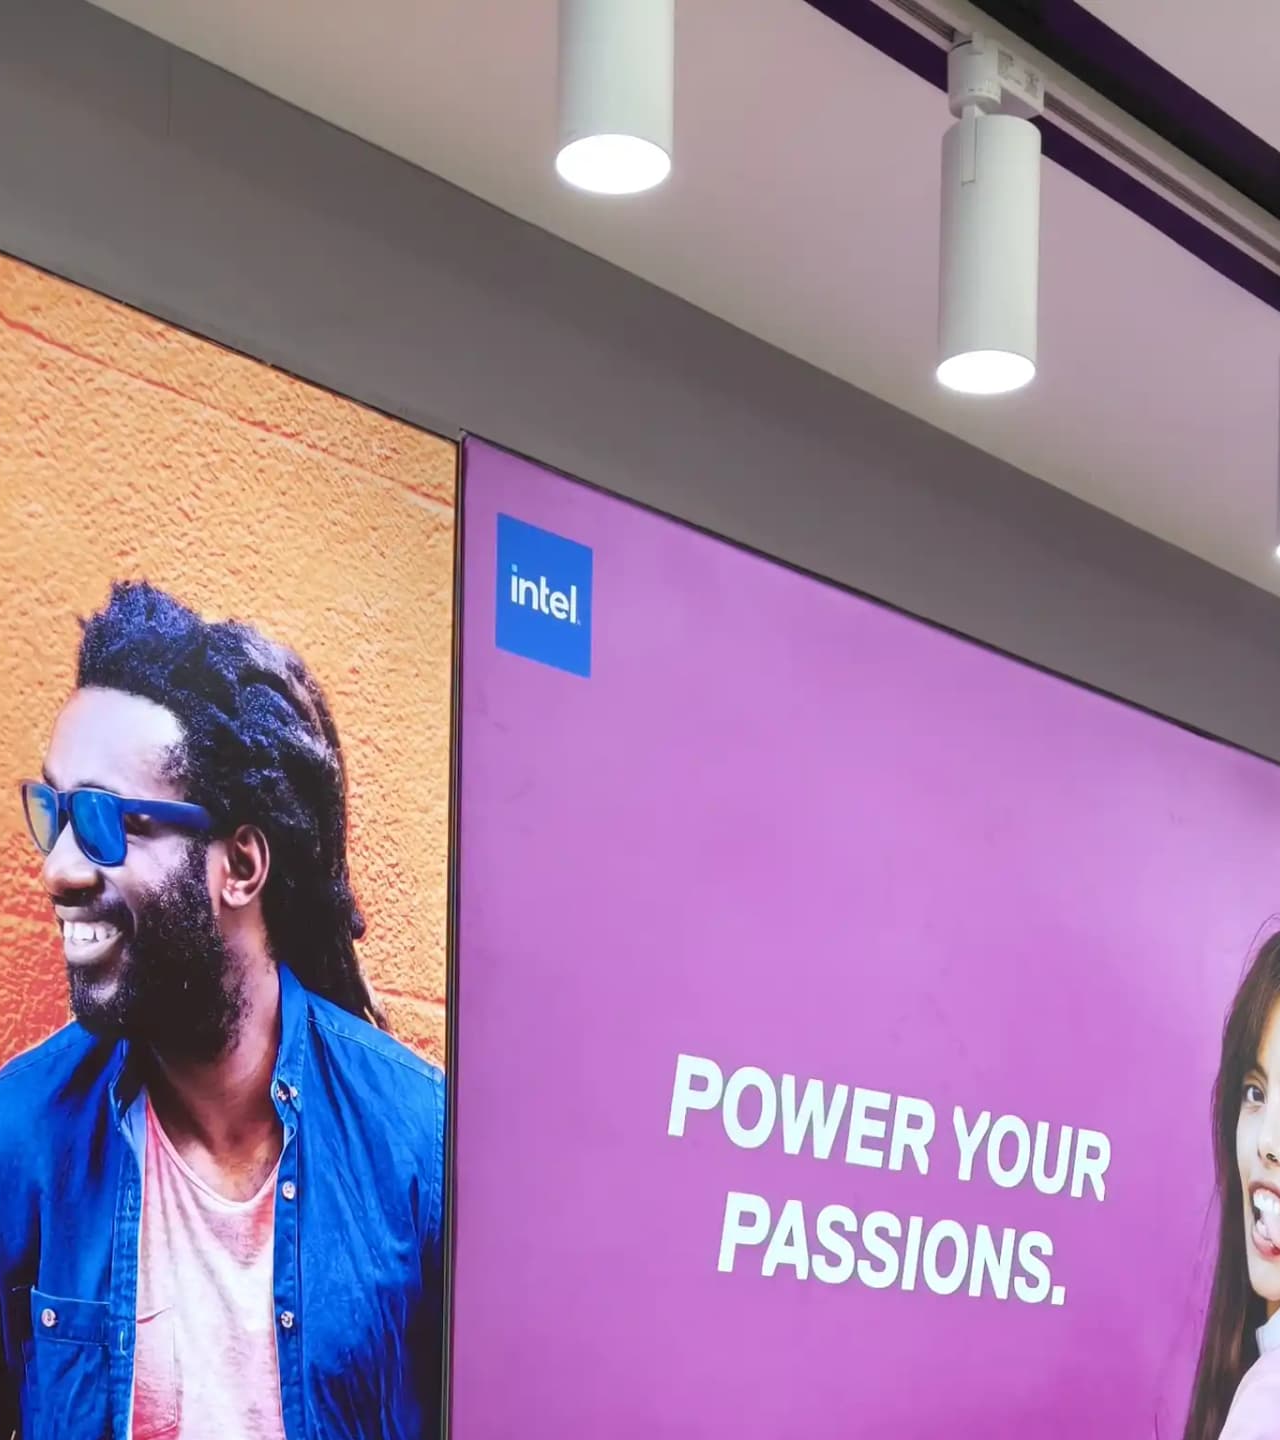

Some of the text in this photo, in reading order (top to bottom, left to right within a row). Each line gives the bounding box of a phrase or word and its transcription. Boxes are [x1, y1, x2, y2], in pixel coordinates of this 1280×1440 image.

[667, 1053, 1112, 1202] POWER YOUR
[717, 1190, 1066, 1306] PASSIONS.
